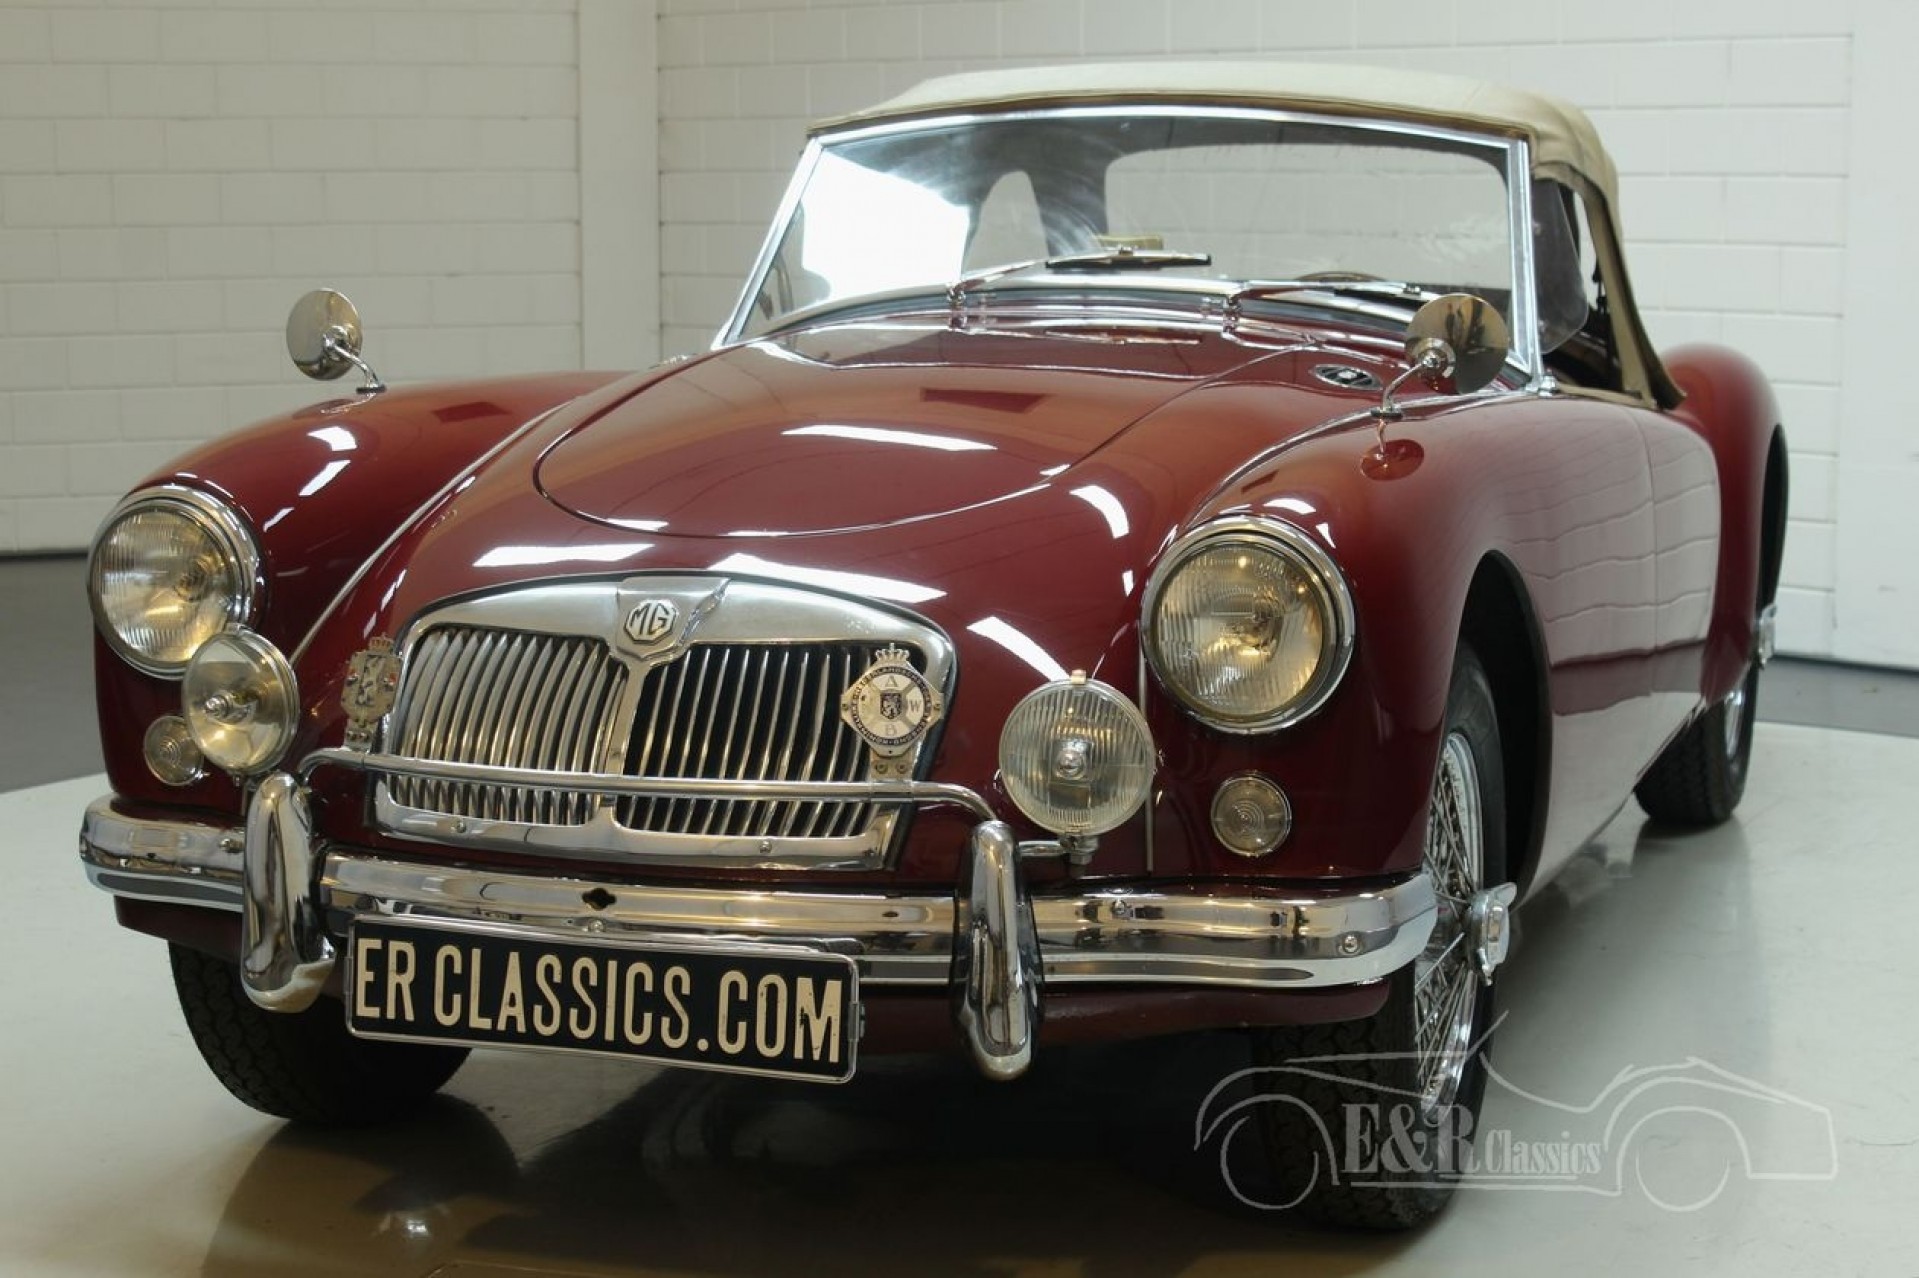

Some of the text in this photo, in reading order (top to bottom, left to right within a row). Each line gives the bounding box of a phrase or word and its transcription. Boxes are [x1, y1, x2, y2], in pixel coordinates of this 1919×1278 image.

[629, 602, 670, 636] MG
[354, 937, 842, 1063] ER CLASSICS.COM
